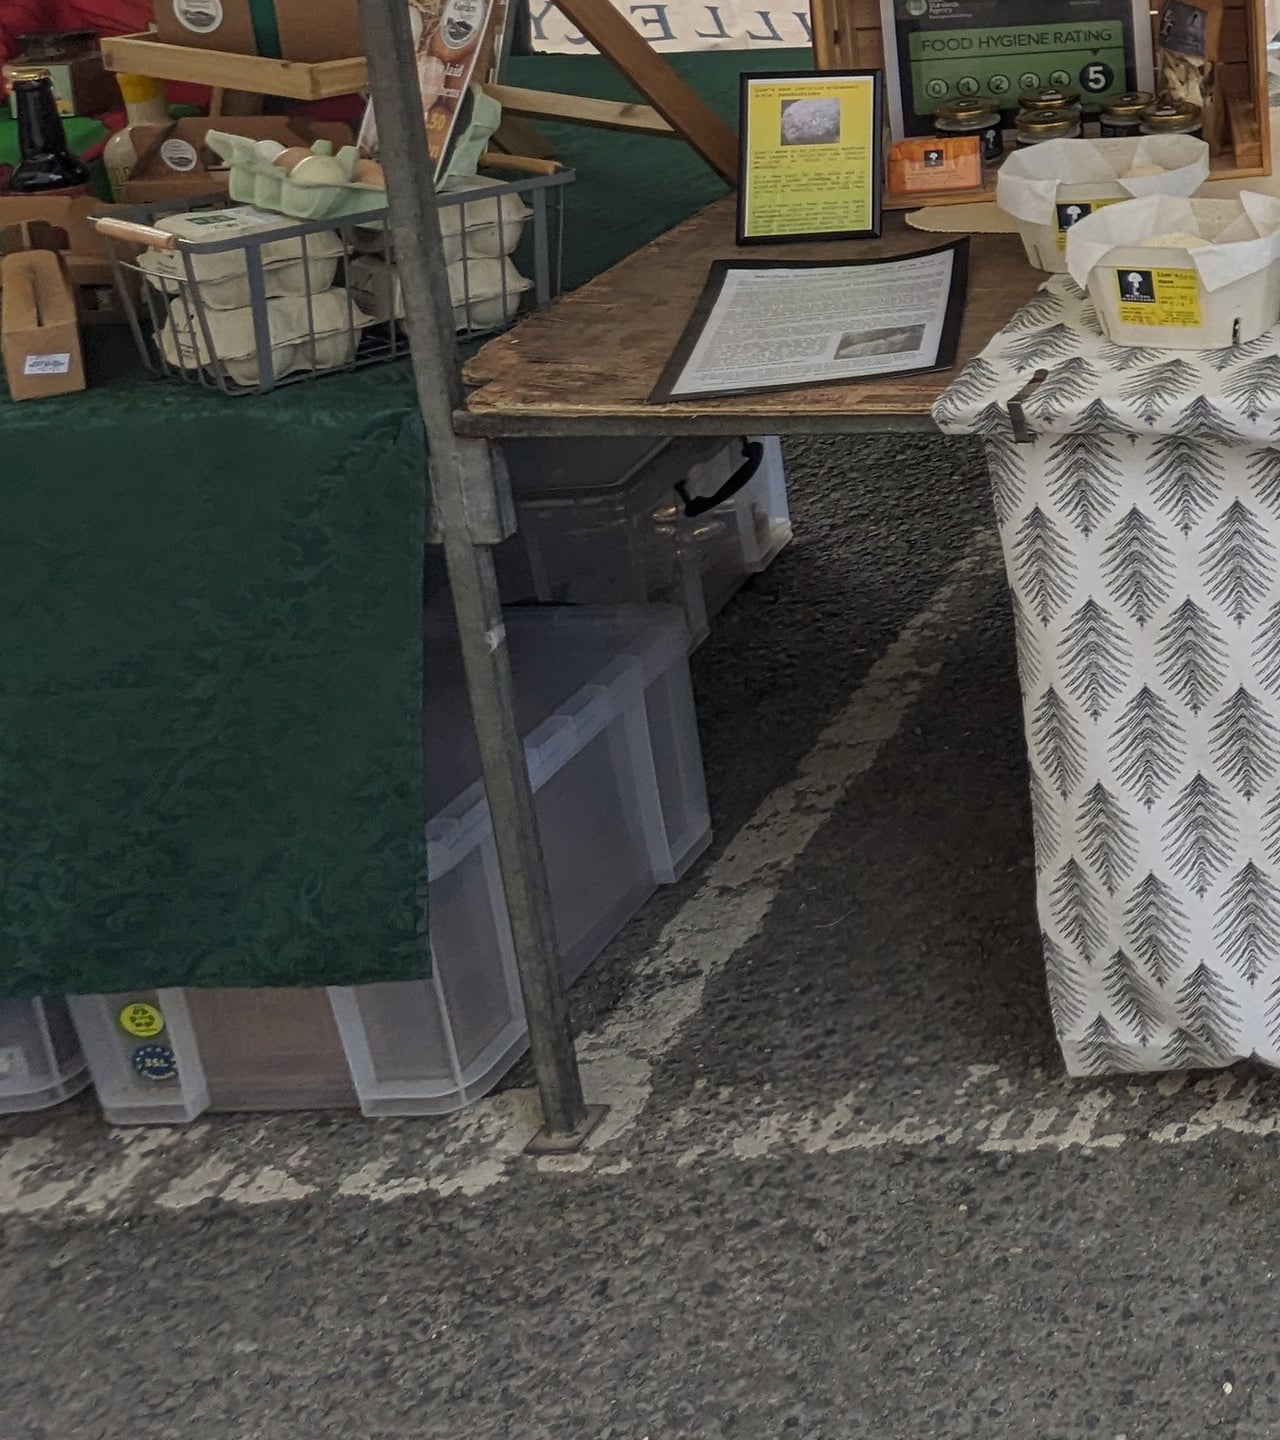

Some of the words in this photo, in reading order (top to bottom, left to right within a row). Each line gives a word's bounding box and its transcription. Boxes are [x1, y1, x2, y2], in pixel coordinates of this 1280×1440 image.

[922, 38, 972, 52] FOOD
[978, 33, 1049, 49] HYGIENE
[1053, 29, 1112, 44] RATING
[1088, 66, 1106, 89] 5
